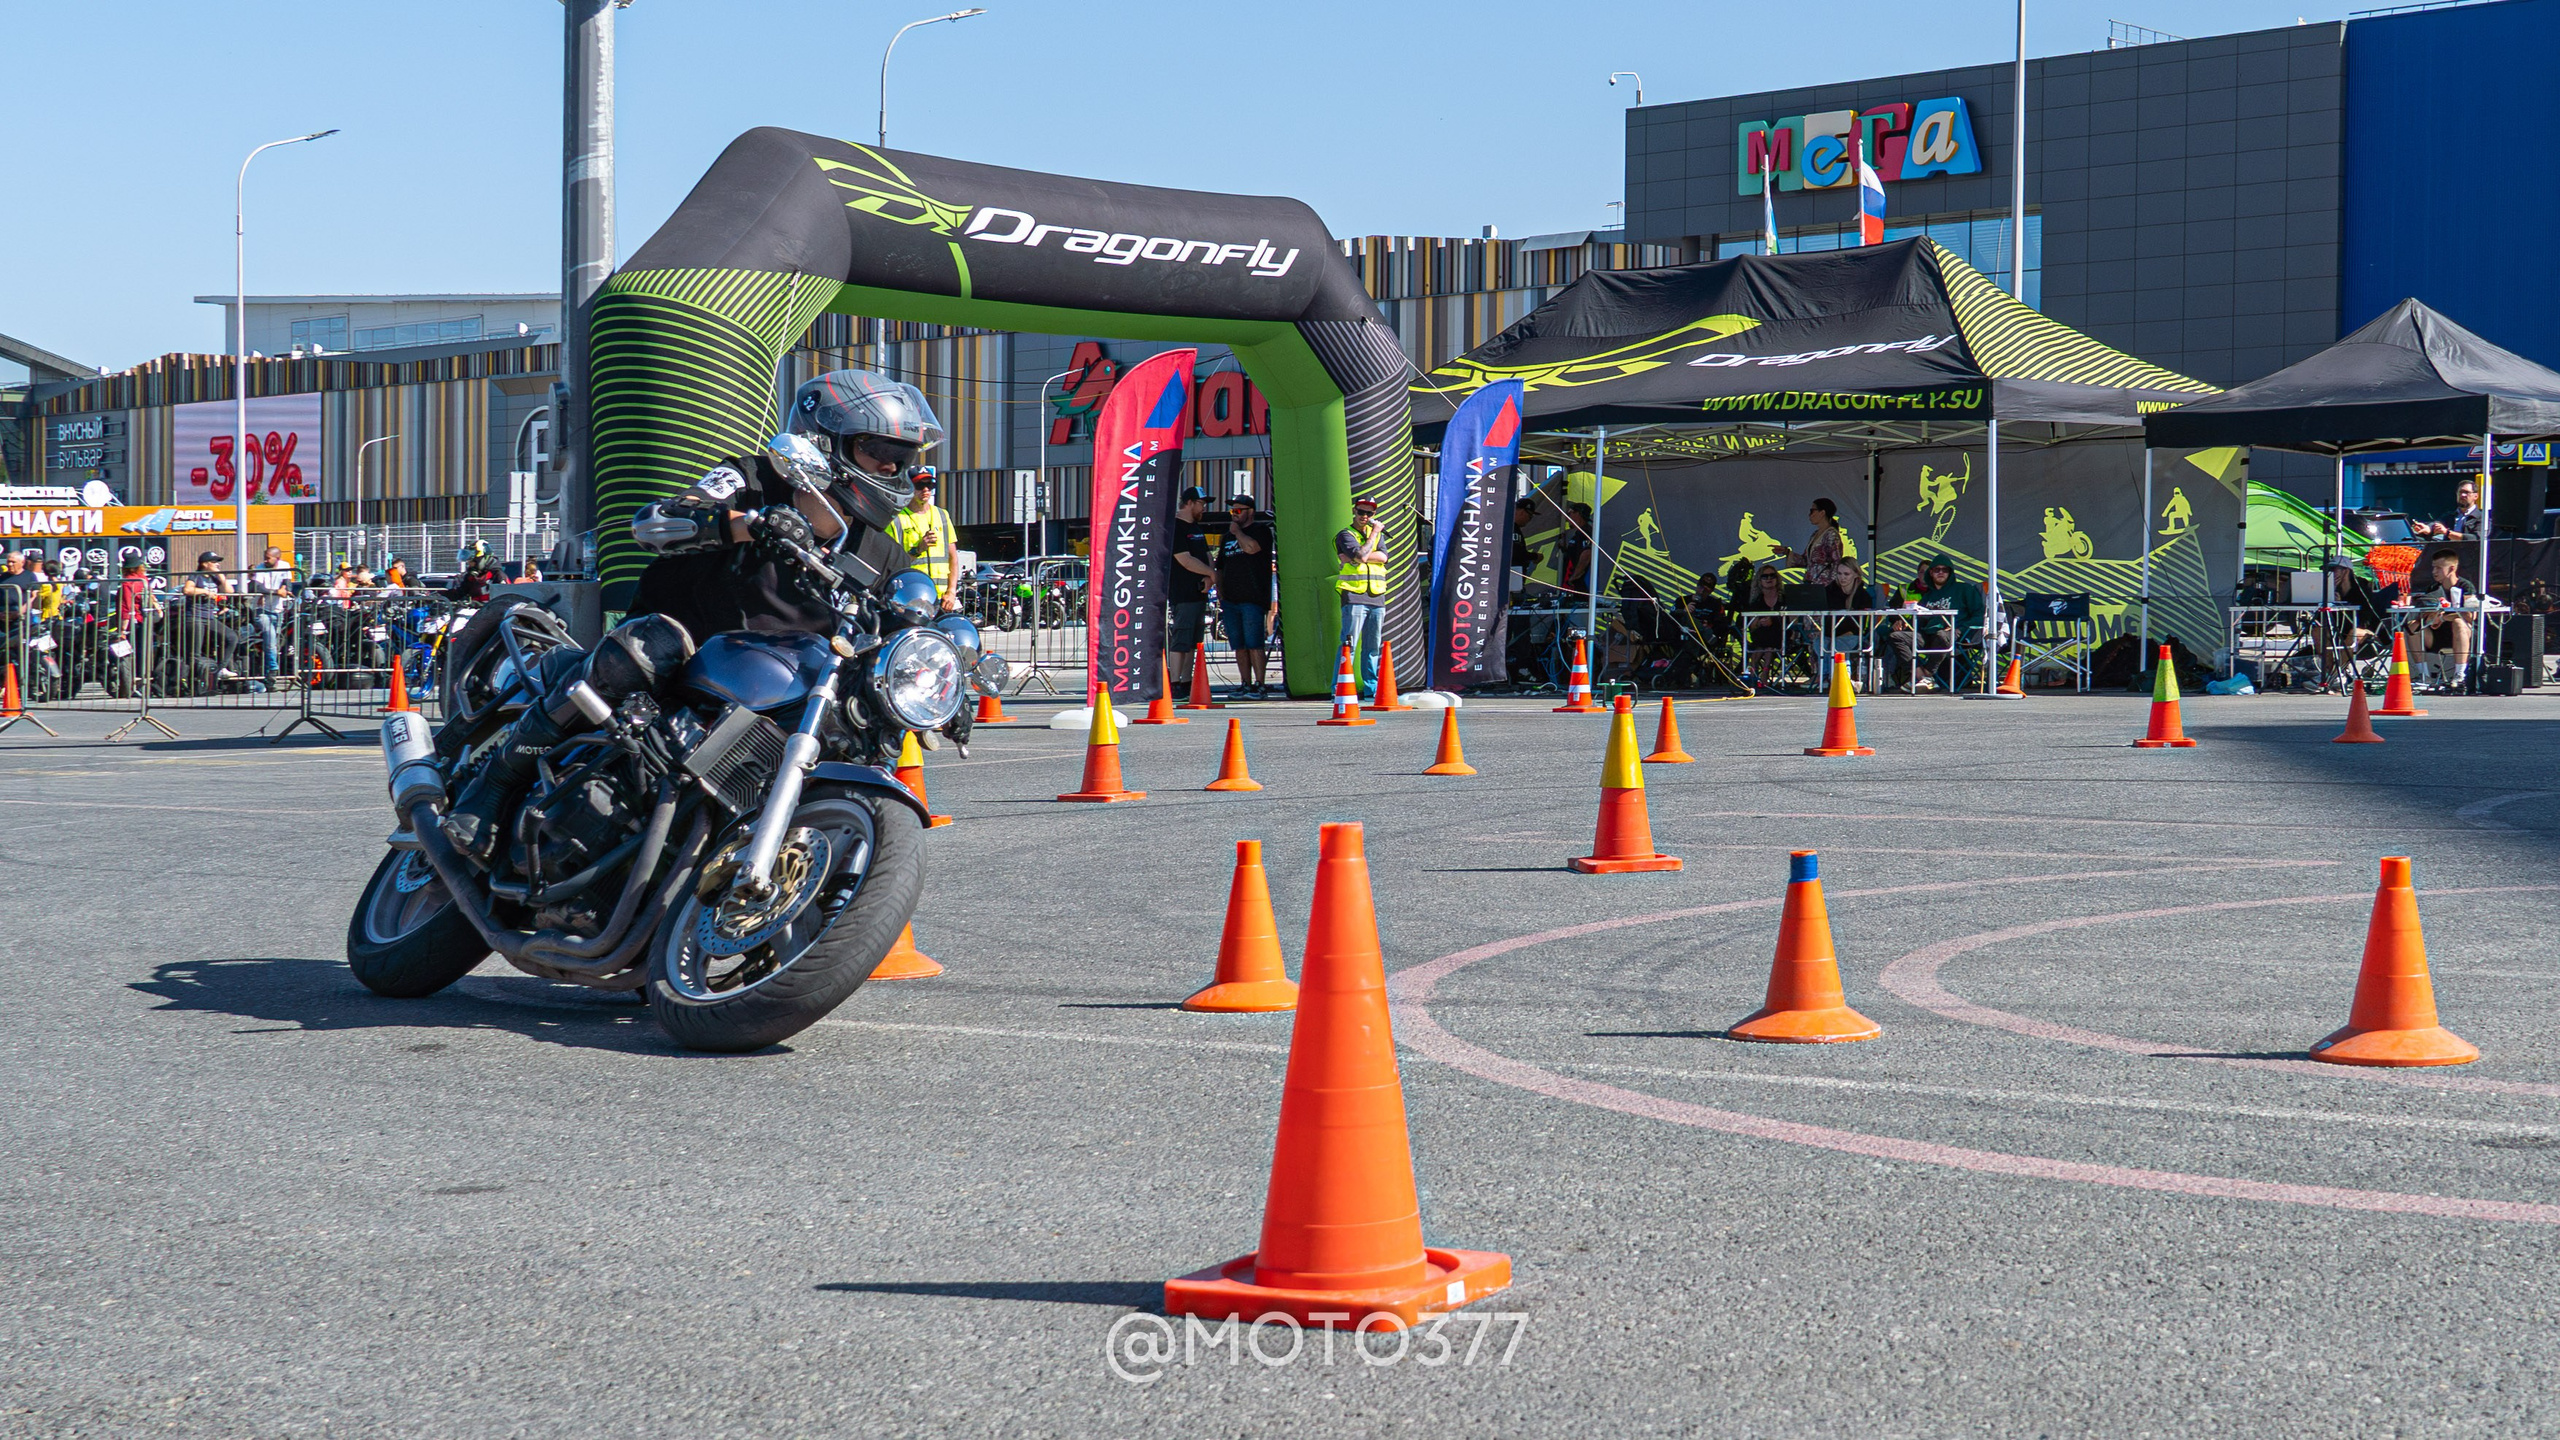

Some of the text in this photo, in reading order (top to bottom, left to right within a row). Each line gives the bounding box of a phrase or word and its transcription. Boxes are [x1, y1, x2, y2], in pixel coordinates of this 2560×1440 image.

[964, 206, 1300, 277] Dragonfly
[1688, 334, 1957, 367] Dragonfly
[1702, 388, 1983, 411] WWW.DRAGON-FLY.SU
[59, 416, 103, 441] ВКУСНЫЙ
[171, 520, 238, 532] ЕВРОПЕЕ
[173, 509, 213, 520] АВТО
[1114, 441, 1143, 692] MOTOGYMKHANA
[1133, 440, 1159, 690] EKATERINBURG TEAM
[1451, 456, 1483, 674] MOTOGYMKHANA
[1474, 457, 1498, 671] EKATERINBURG TEAM
